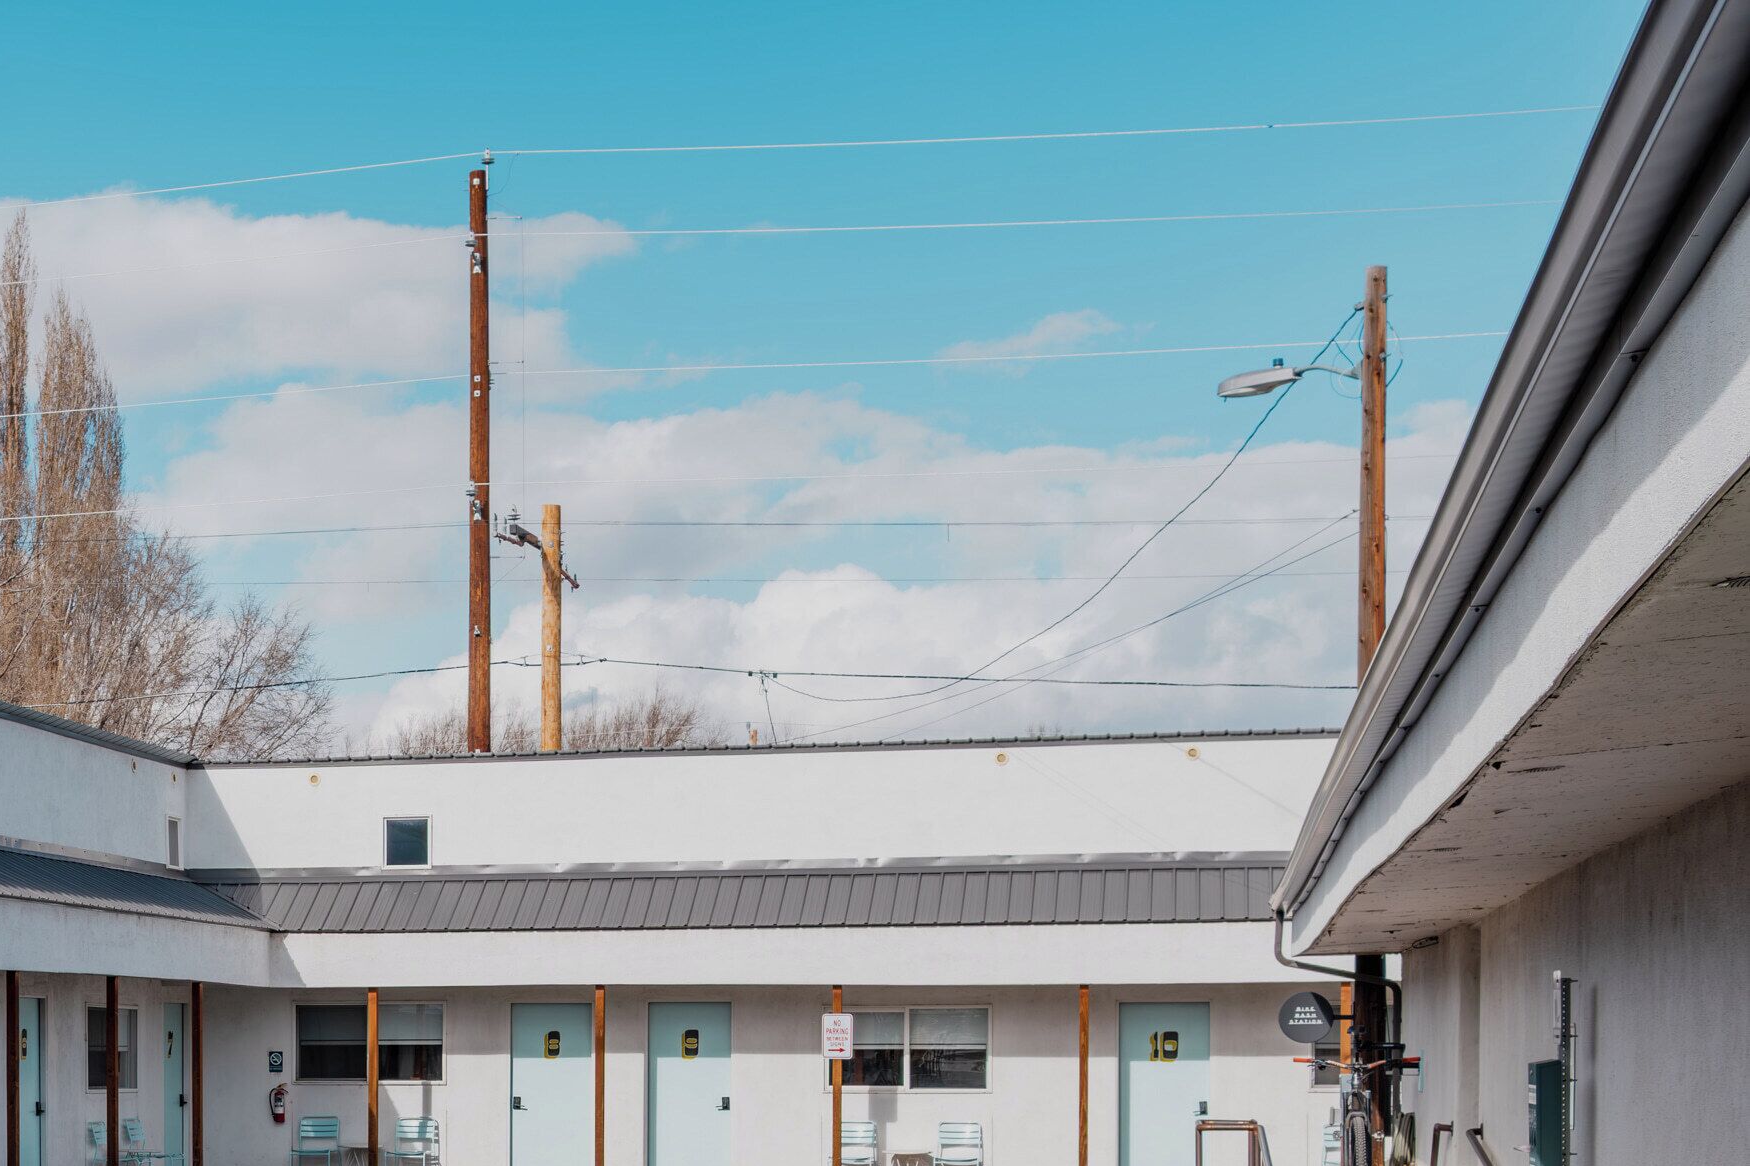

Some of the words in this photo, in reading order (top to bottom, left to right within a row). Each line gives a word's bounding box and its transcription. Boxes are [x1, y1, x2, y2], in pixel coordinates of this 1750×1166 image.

[544, 1030, 561, 1059] 8
[681, 1029, 699, 1060] 9
[1150, 1031, 1179, 1062] 10
